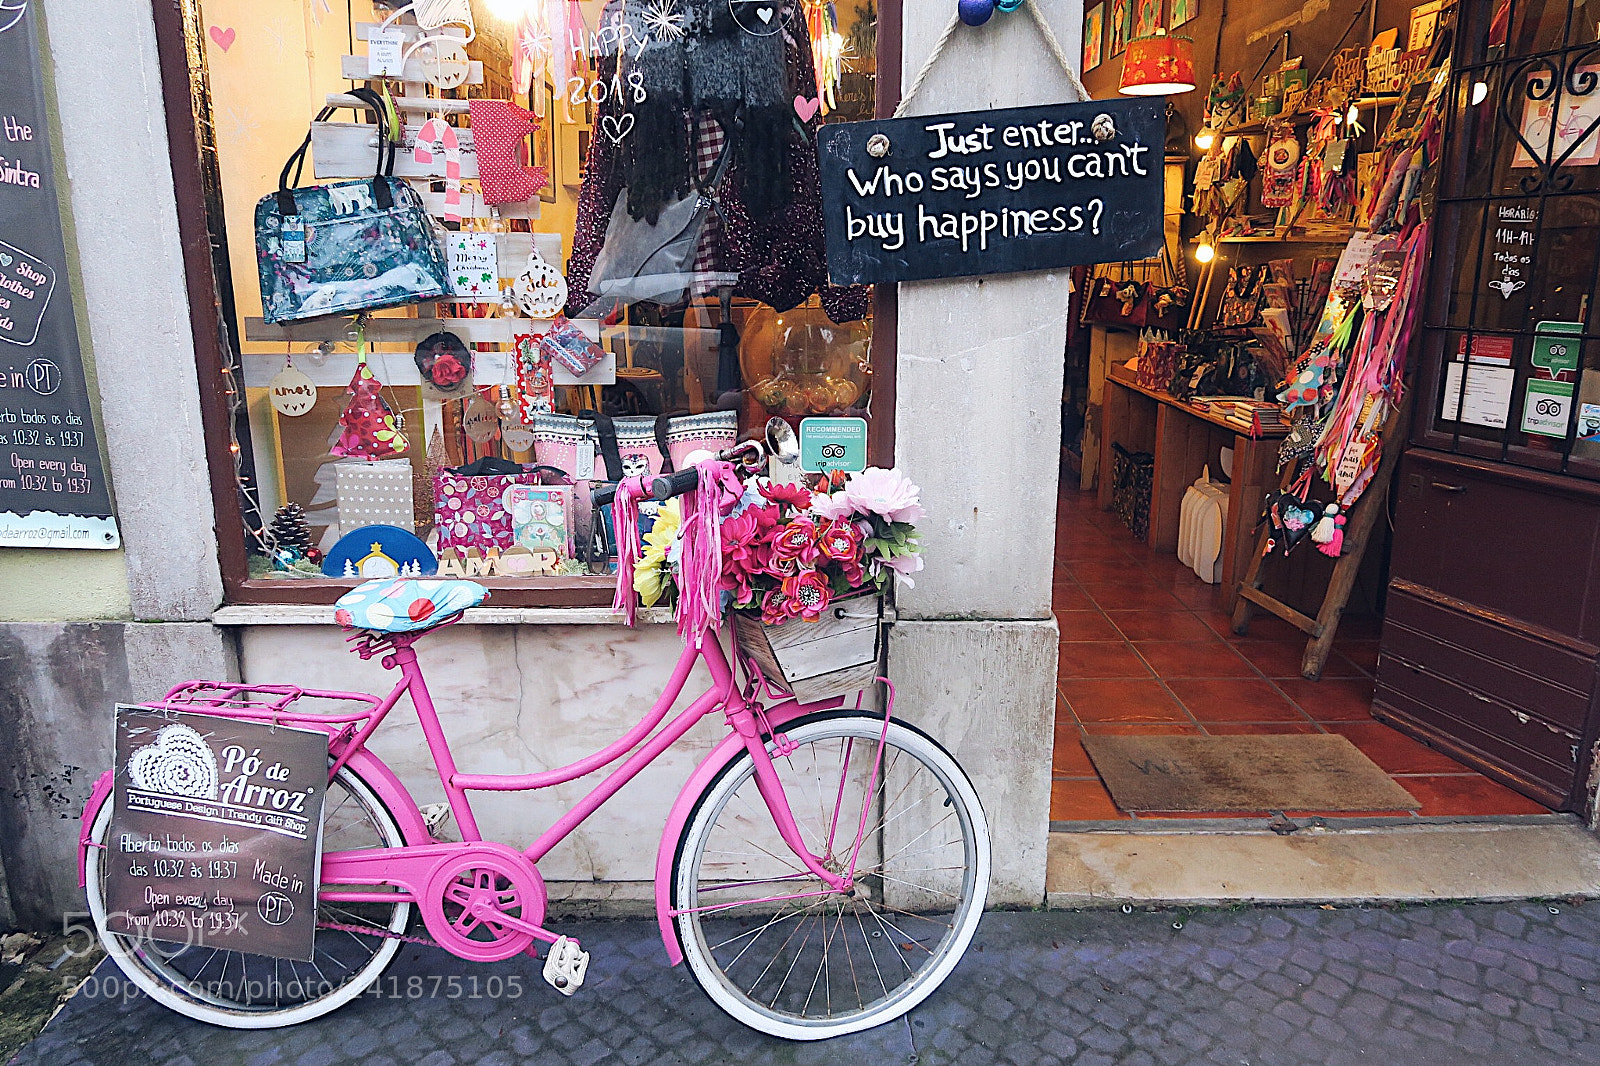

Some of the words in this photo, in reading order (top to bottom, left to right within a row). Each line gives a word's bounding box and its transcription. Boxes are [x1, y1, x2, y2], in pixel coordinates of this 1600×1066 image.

[569, 23, 649, 62] HAPPY
[568, 73, 647, 105] 2018
[3, 115, 33, 141] the
[925, 122, 995, 159] Just
[847, 165, 924, 197] Who
[931, 163, 1000, 199] says
[1004, 157, 1062, 190] you
[1067, 142, 1149, 178] can't
[846, 205, 905, 250] buy
[918, 198, 1104, 252] happiness?
[454, 253, 488, 263] Merry
[1493, 251, 1518, 263] Todos
[1520, 256, 1531, 264] os
[1501, 263, 1520, 277] dias
[16, 262, 47, 286] Shop
[0, 296, 11, 310] es
[0, 314, 14, 331] ds
[10, 366, 25, 388] in
[33, 363, 53, 390] PT
[0, 408, 16, 423] rto
[20, 408, 47, 424] todos
[51, 415, 61, 425] os
[65, 409, 83, 425] dias
[1527, 416, 1565, 428] tripadvisor
[13, 430, 40, 445] 10:32
[45, 433, 56, 446] às
[60, 431, 84, 447] 19:37
[10, 452, 35, 475] Open
[40, 459, 66, 477] every
[70, 457, 87, 478] day
[20, 475, 48, 491] 10:32
[52, 477, 63, 492] to
[67, 477, 91, 494] 19:37
[436, 546, 558, 577] AMOR
[221, 744, 263, 777] Pó
[265, 762, 290, 782] de
[128, 794, 182, 810] Portuguese
[185, 802, 219, 816] Design
[227, 808, 262, 823] Trendy
[265, 815, 284, 826] Gift
[285, 818, 306, 833] Shop
[120, 833, 161, 852] Aberto
[166, 833, 196, 852] todos
[202, 841, 213, 853] os
[219, 835, 239, 854] dias
[129, 859, 149, 877] das
[153, 859, 184, 878] 10:32
[190, 862, 203, 878] às
[208, 860, 237, 879] 19:37
[252, 858, 289, 889] Made
[291, 873, 304, 894] in
[144, 885, 170, 911] Open
[175, 894, 208, 912] every
[212, 889, 235, 913] day
[265, 895, 288, 922] PT
[126, 909, 150, 930] from
[155, 909, 186, 928] 10:32
[191, 910, 204, 929] to
[209, 912, 239, 930] 19:37
